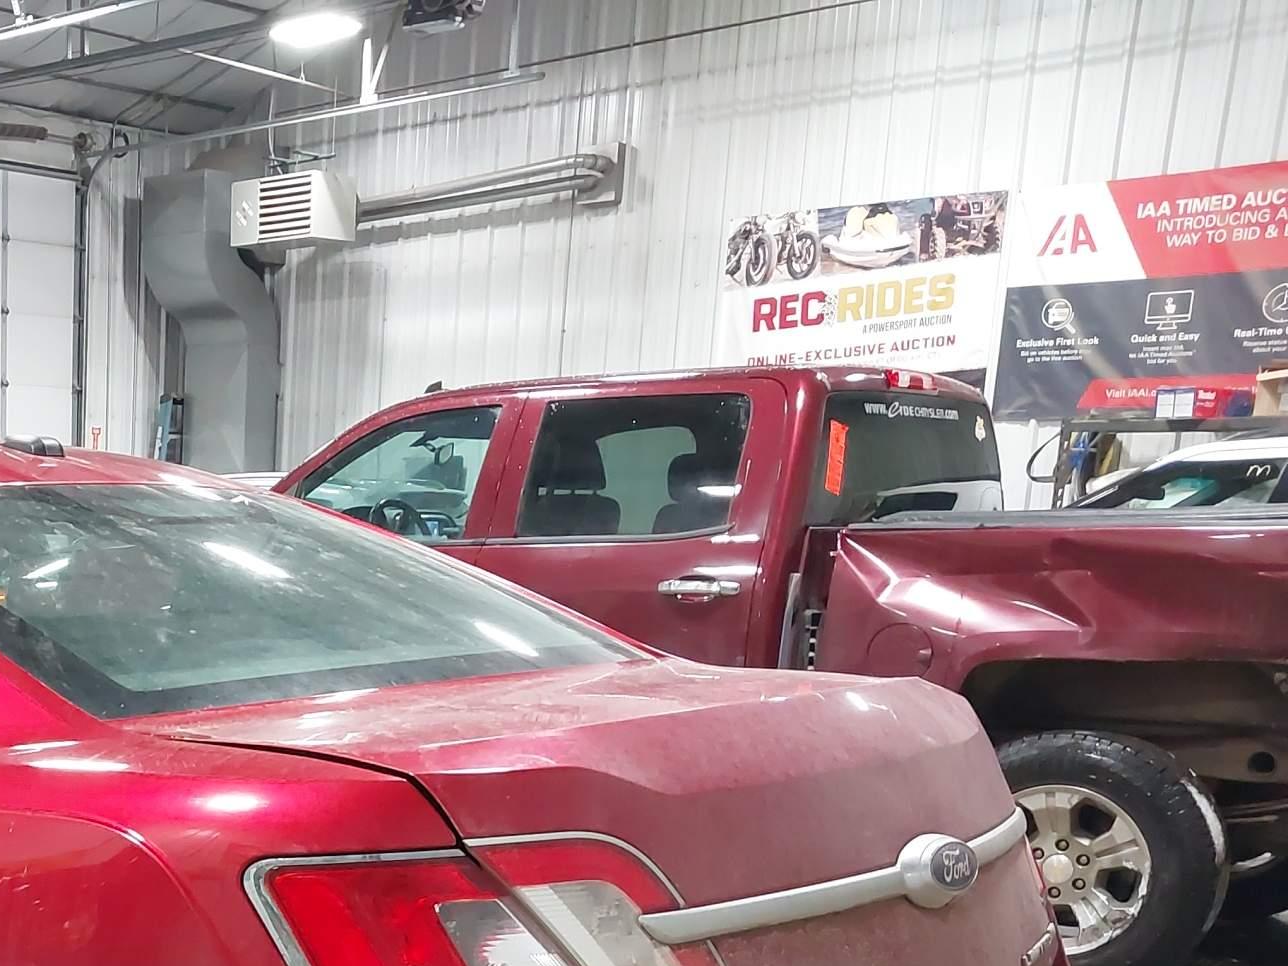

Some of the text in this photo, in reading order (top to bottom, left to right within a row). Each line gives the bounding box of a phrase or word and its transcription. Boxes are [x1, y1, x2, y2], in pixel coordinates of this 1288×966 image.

[1136, 187, 1288, 219] IAA TIMED AUC
[1157, 208, 1271, 233] INTRODUCING
[1166, 223, 1279, 249] WAY TO BID &
[752, 272, 957, 333] REC RIDES
[862, 313, 953, 335] A POWERSPORT AUCTION
[1233, 326, 1284, 338] Real-Time
[1016, 335, 1100, 349] Exclusive First Look
[1130, 331, 1201, 343] Quick and Easy
[747, 341, 886, 368] ONLINE-EXCLUSIVE
[889, 334, 957, 352] AUCTION
[1105, 388, 1127, 399] Visit
[941, 848, 971, 883] Ford
